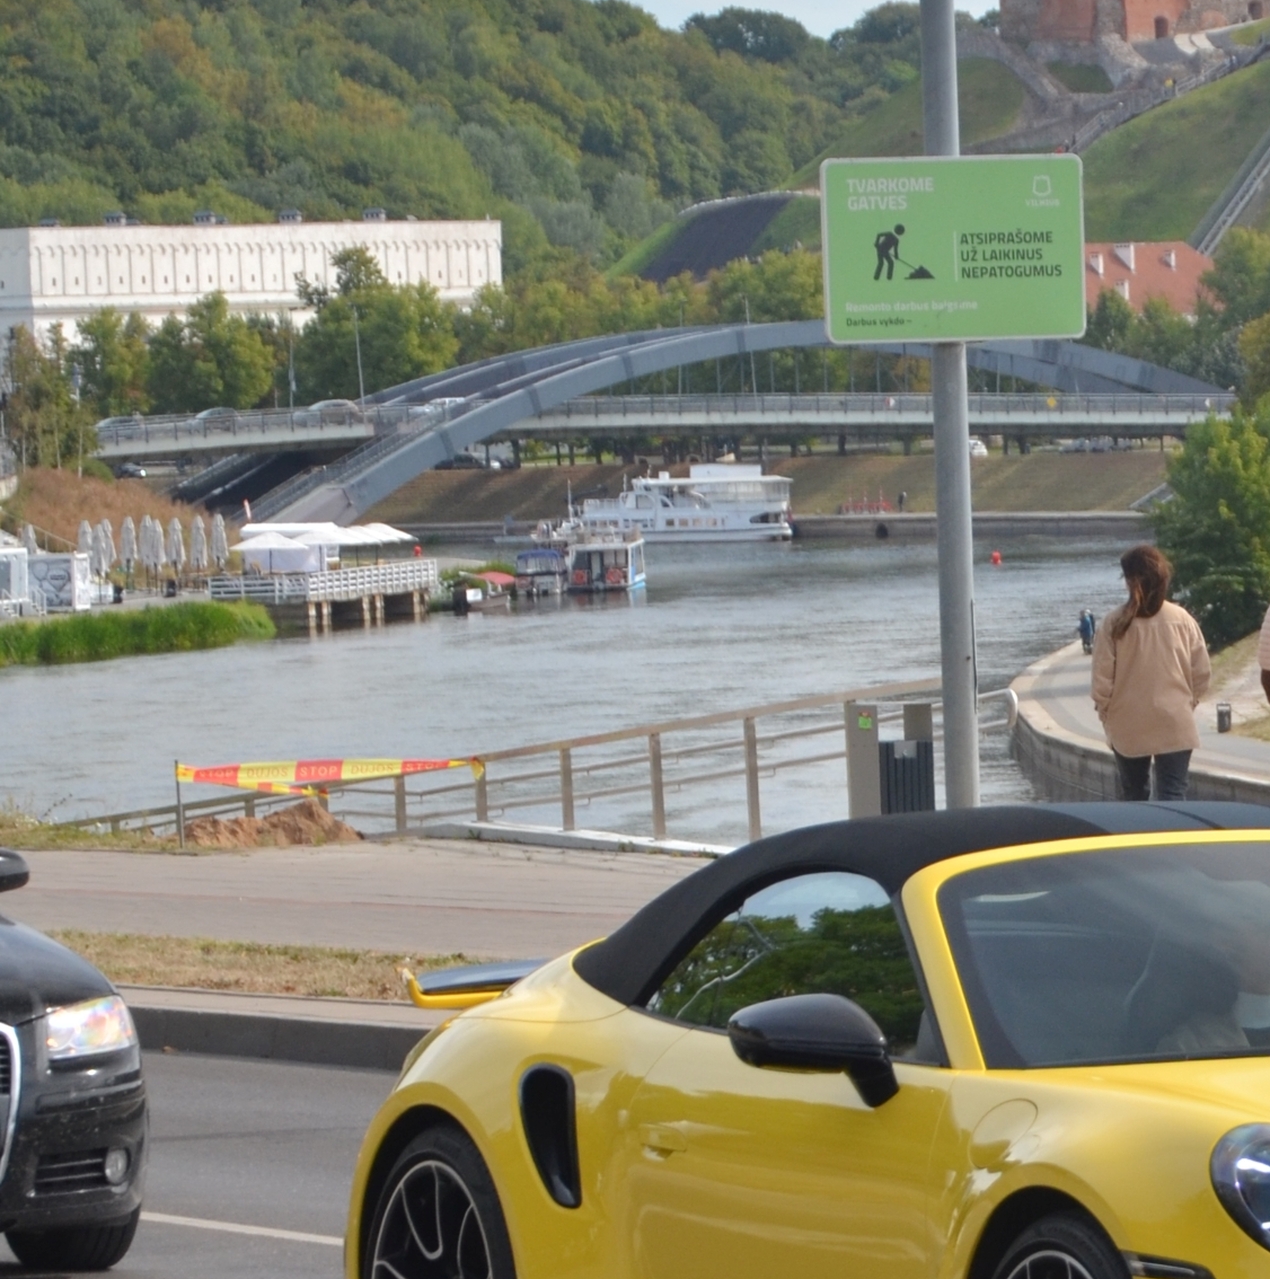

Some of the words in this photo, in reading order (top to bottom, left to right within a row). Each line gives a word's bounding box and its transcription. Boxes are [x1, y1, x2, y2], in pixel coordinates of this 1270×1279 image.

[846, 177, 934, 193] TVARKOME
[847, 195, 907, 211] GATVES
[960, 228, 1053, 246] ATSIPRAŠOME
[961, 246, 978, 262] UŽ
[982, 248, 1043, 261] LAIKINUS
[961, 264, 1063, 279] NEPATOGUMUS
[845, 302, 891, 313] Remonto
[894, 301, 929, 311] darbus
[846, 317, 877, 327] Darbus
[879, 316, 905, 328] vykdo
[299, 765, 338, 777] STOP
